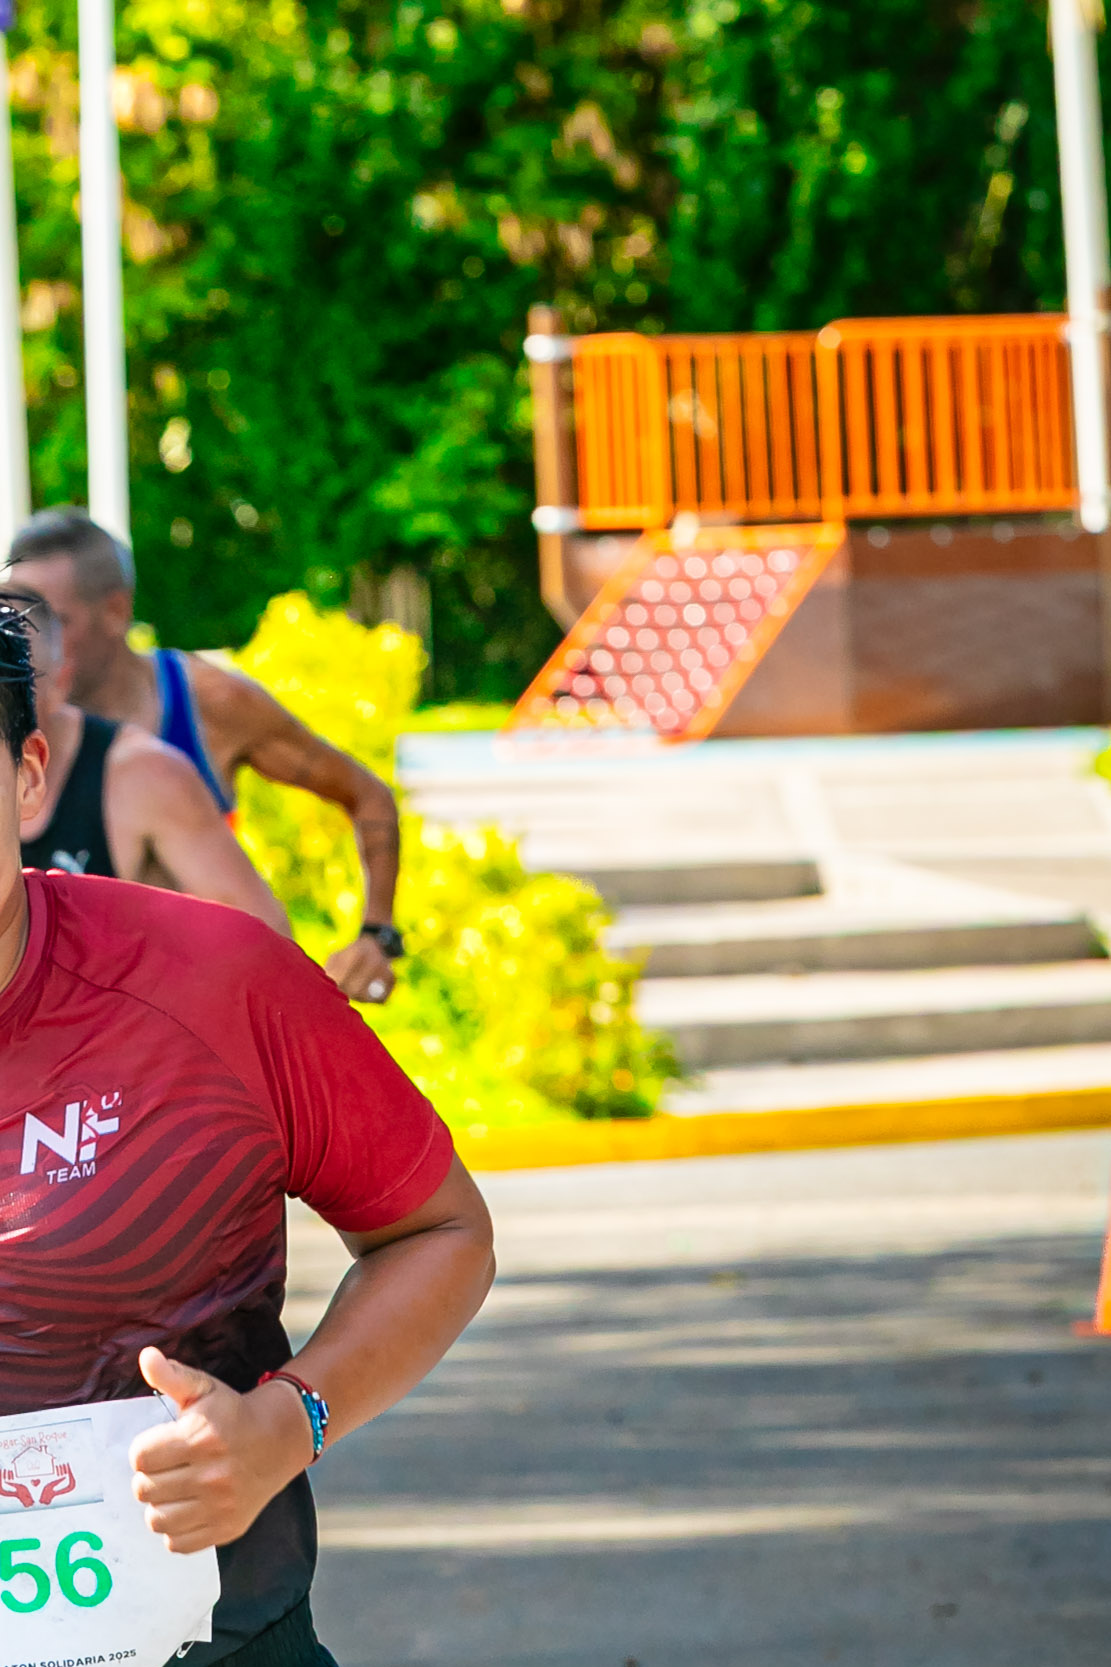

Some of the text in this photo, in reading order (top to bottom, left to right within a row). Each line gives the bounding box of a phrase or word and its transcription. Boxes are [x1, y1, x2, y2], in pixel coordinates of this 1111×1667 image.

[46, 1161, 97, 1185] TEAM
[19, 1435, 37, 1447] San
[38, 1431, 68, 1444] Roque
[108, 1649, 137, 1662] 2025
